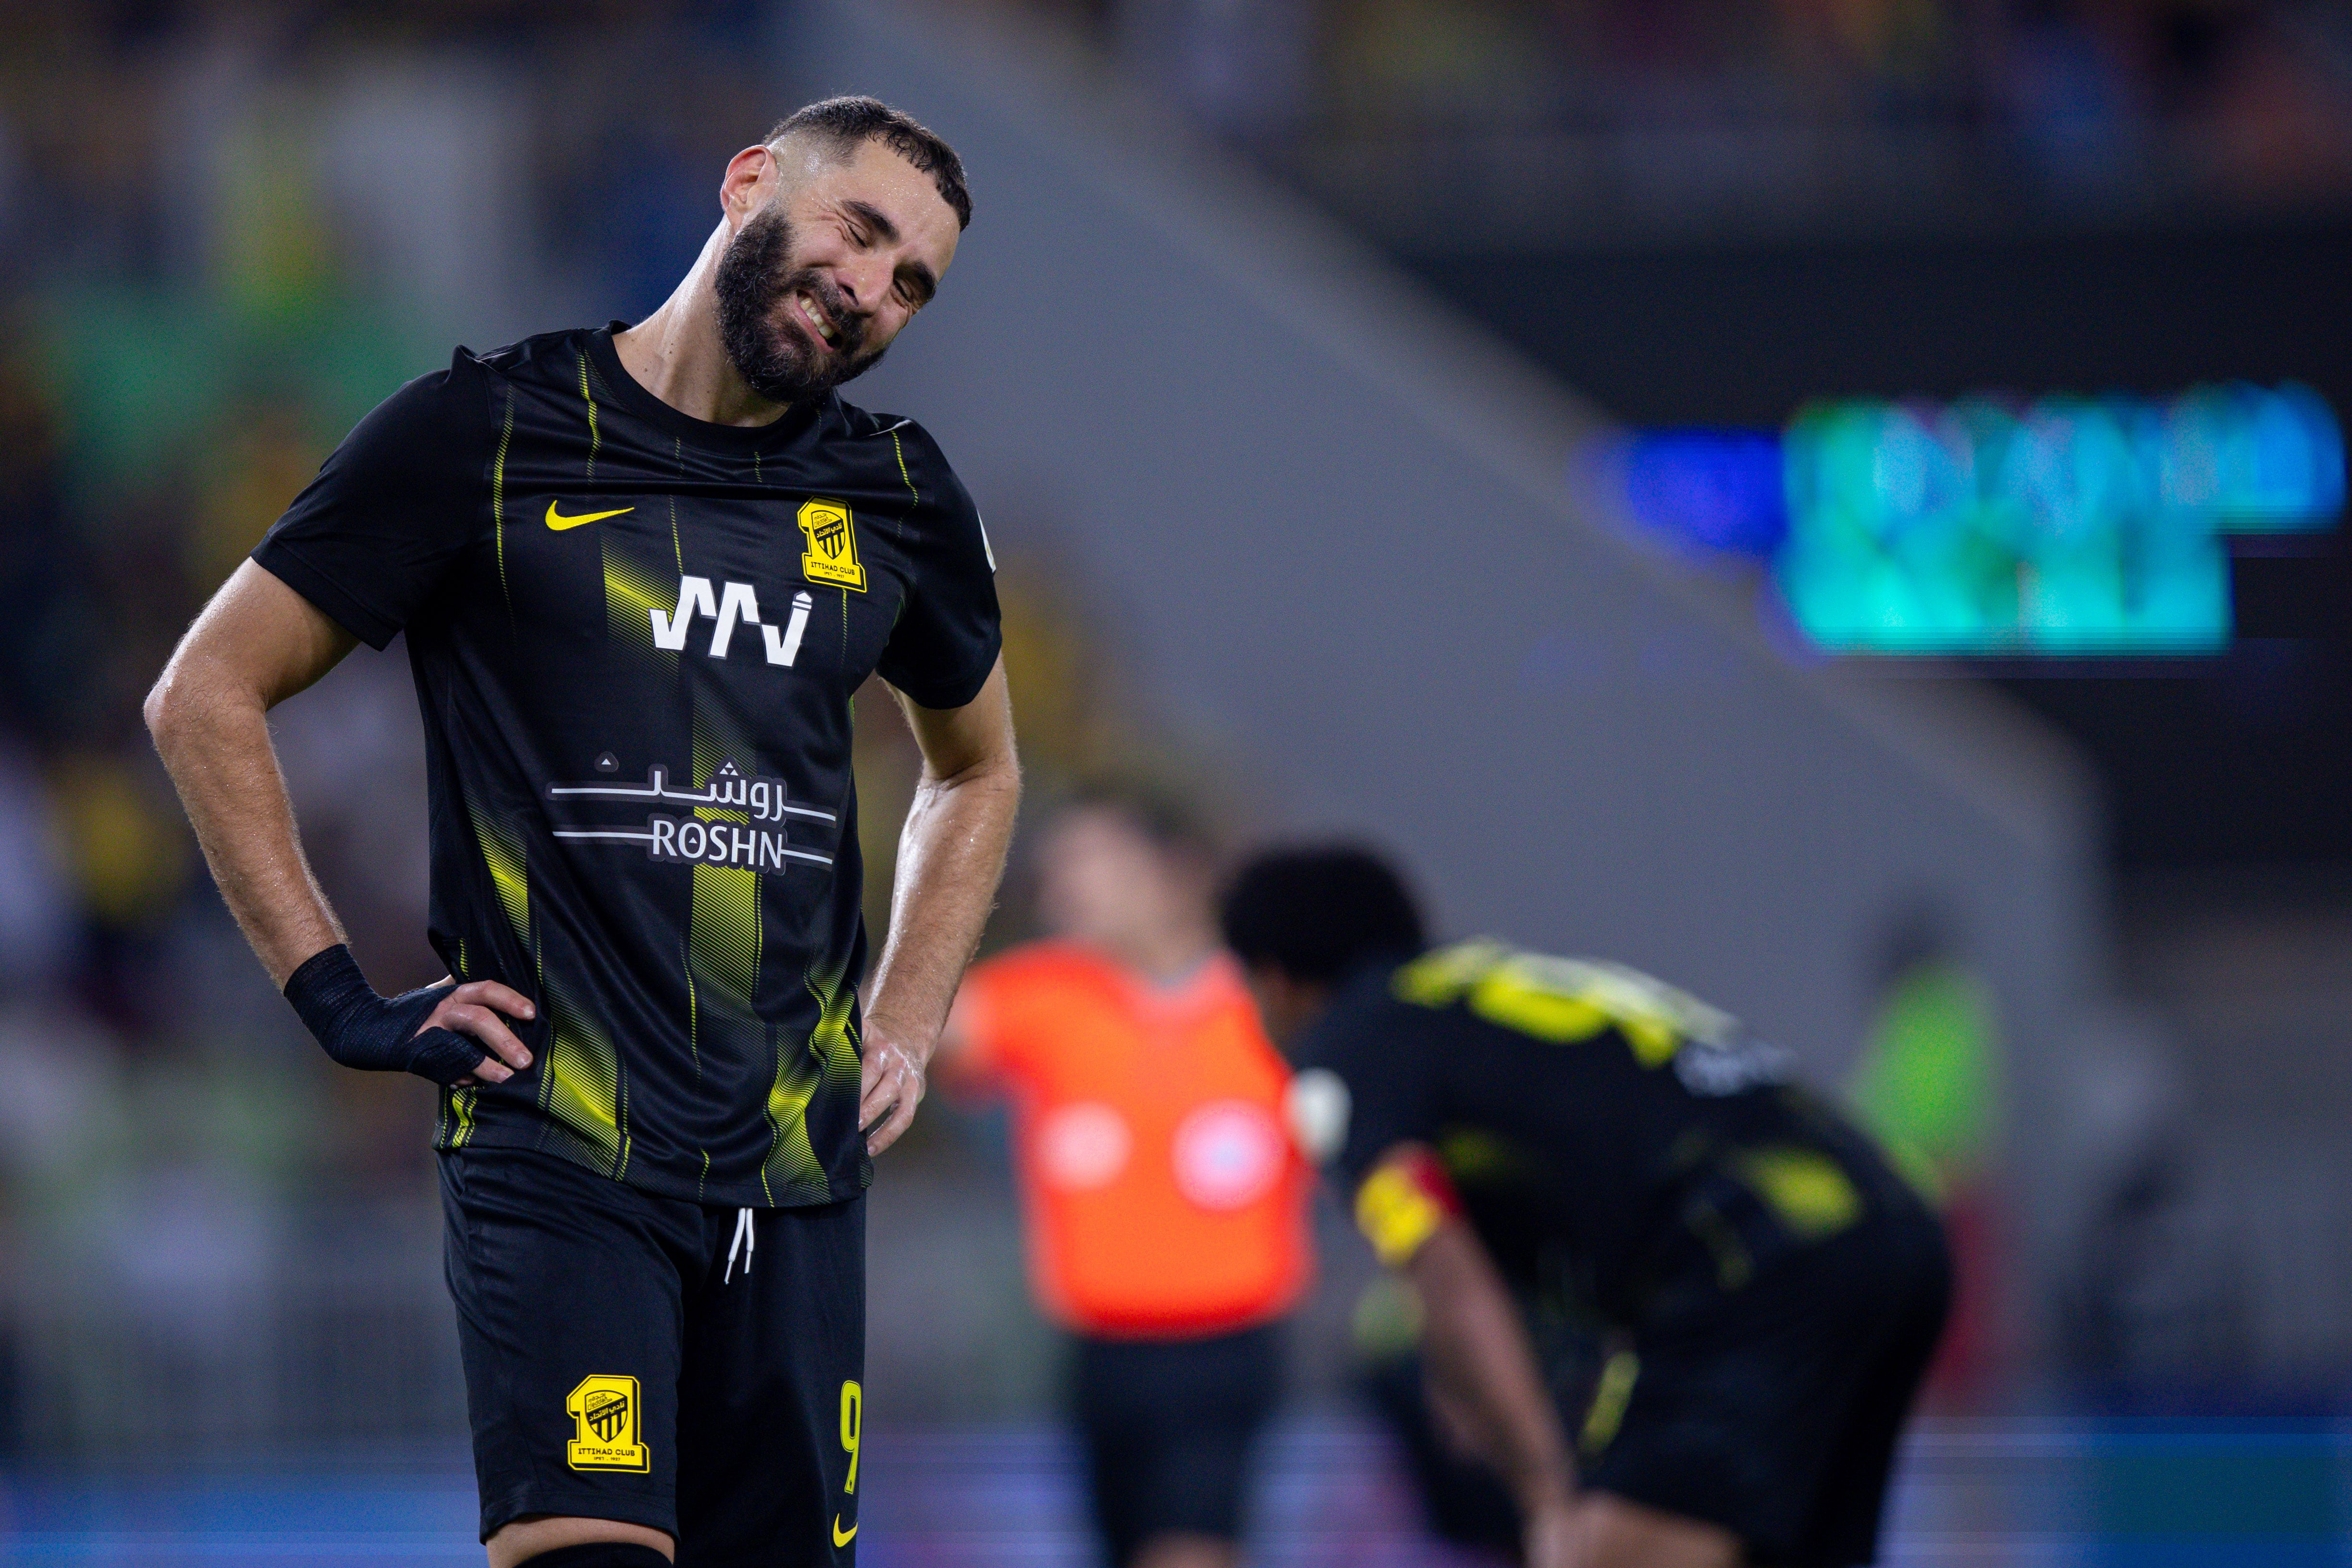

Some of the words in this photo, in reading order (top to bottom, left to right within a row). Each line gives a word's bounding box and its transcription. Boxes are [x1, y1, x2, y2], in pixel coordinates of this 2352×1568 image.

[816, 527, 831, 538] الاتحاد
[830, 522, 842, 533] نادي
[839, 567, 855, 575] CLUB
[653, 820, 782, 868] ROSHN
[589, 1407, 608, 1421] الاتحاد
[609, 1401, 625, 1414] نادي
[840, 1380, 862, 1494] 9
